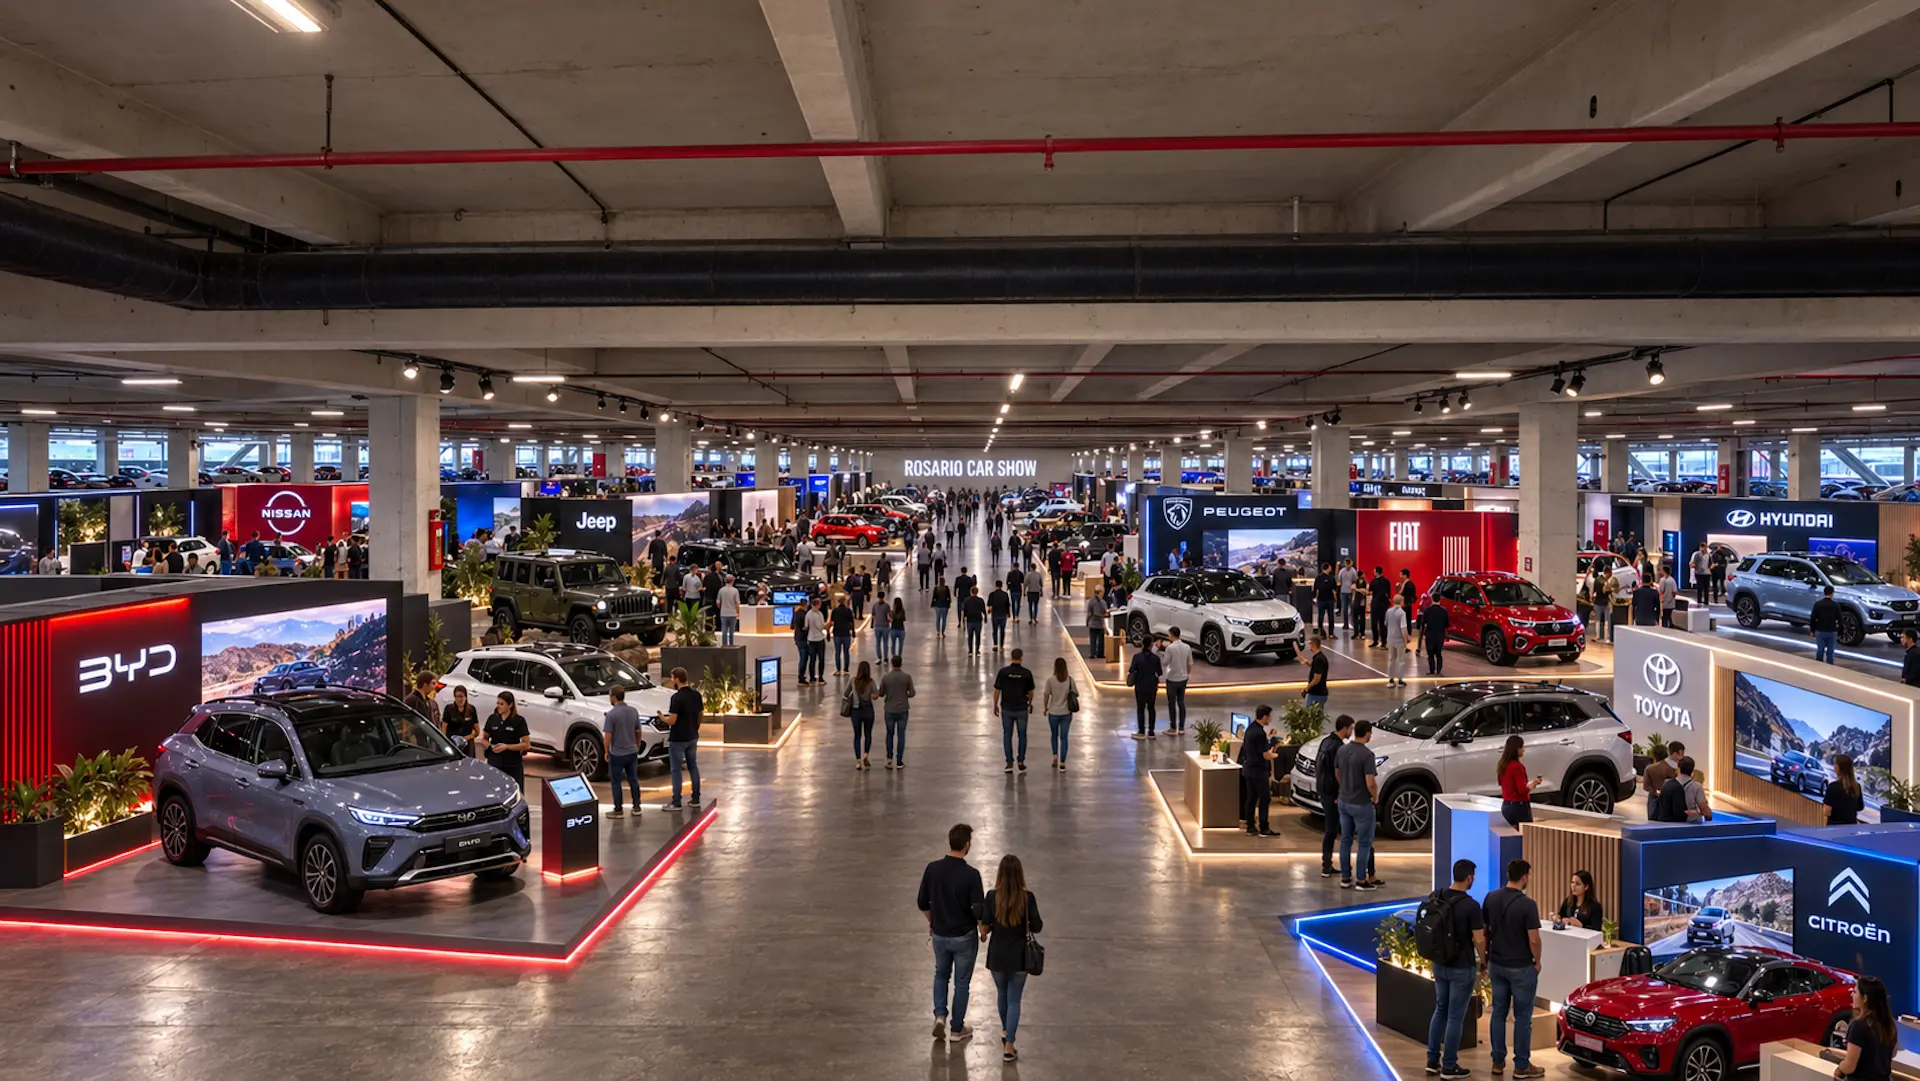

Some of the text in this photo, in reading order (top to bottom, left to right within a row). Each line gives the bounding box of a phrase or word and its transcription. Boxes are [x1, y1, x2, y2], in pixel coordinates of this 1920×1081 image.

[904, 459, 1037, 477] ROSARIO CAR SHOW
[261, 508, 311, 518] NISSAN
[1203, 506, 1287, 517] PEUGEOT
[1760, 512, 1833, 528] HYUNDAI
[575, 511, 617, 533] Jeep
[1389, 522, 1420, 551] FIAT
[79, 643, 177, 694] BYD
[1633, 693, 1693, 731] TOYOTA
[566, 814, 593, 828] BYD
